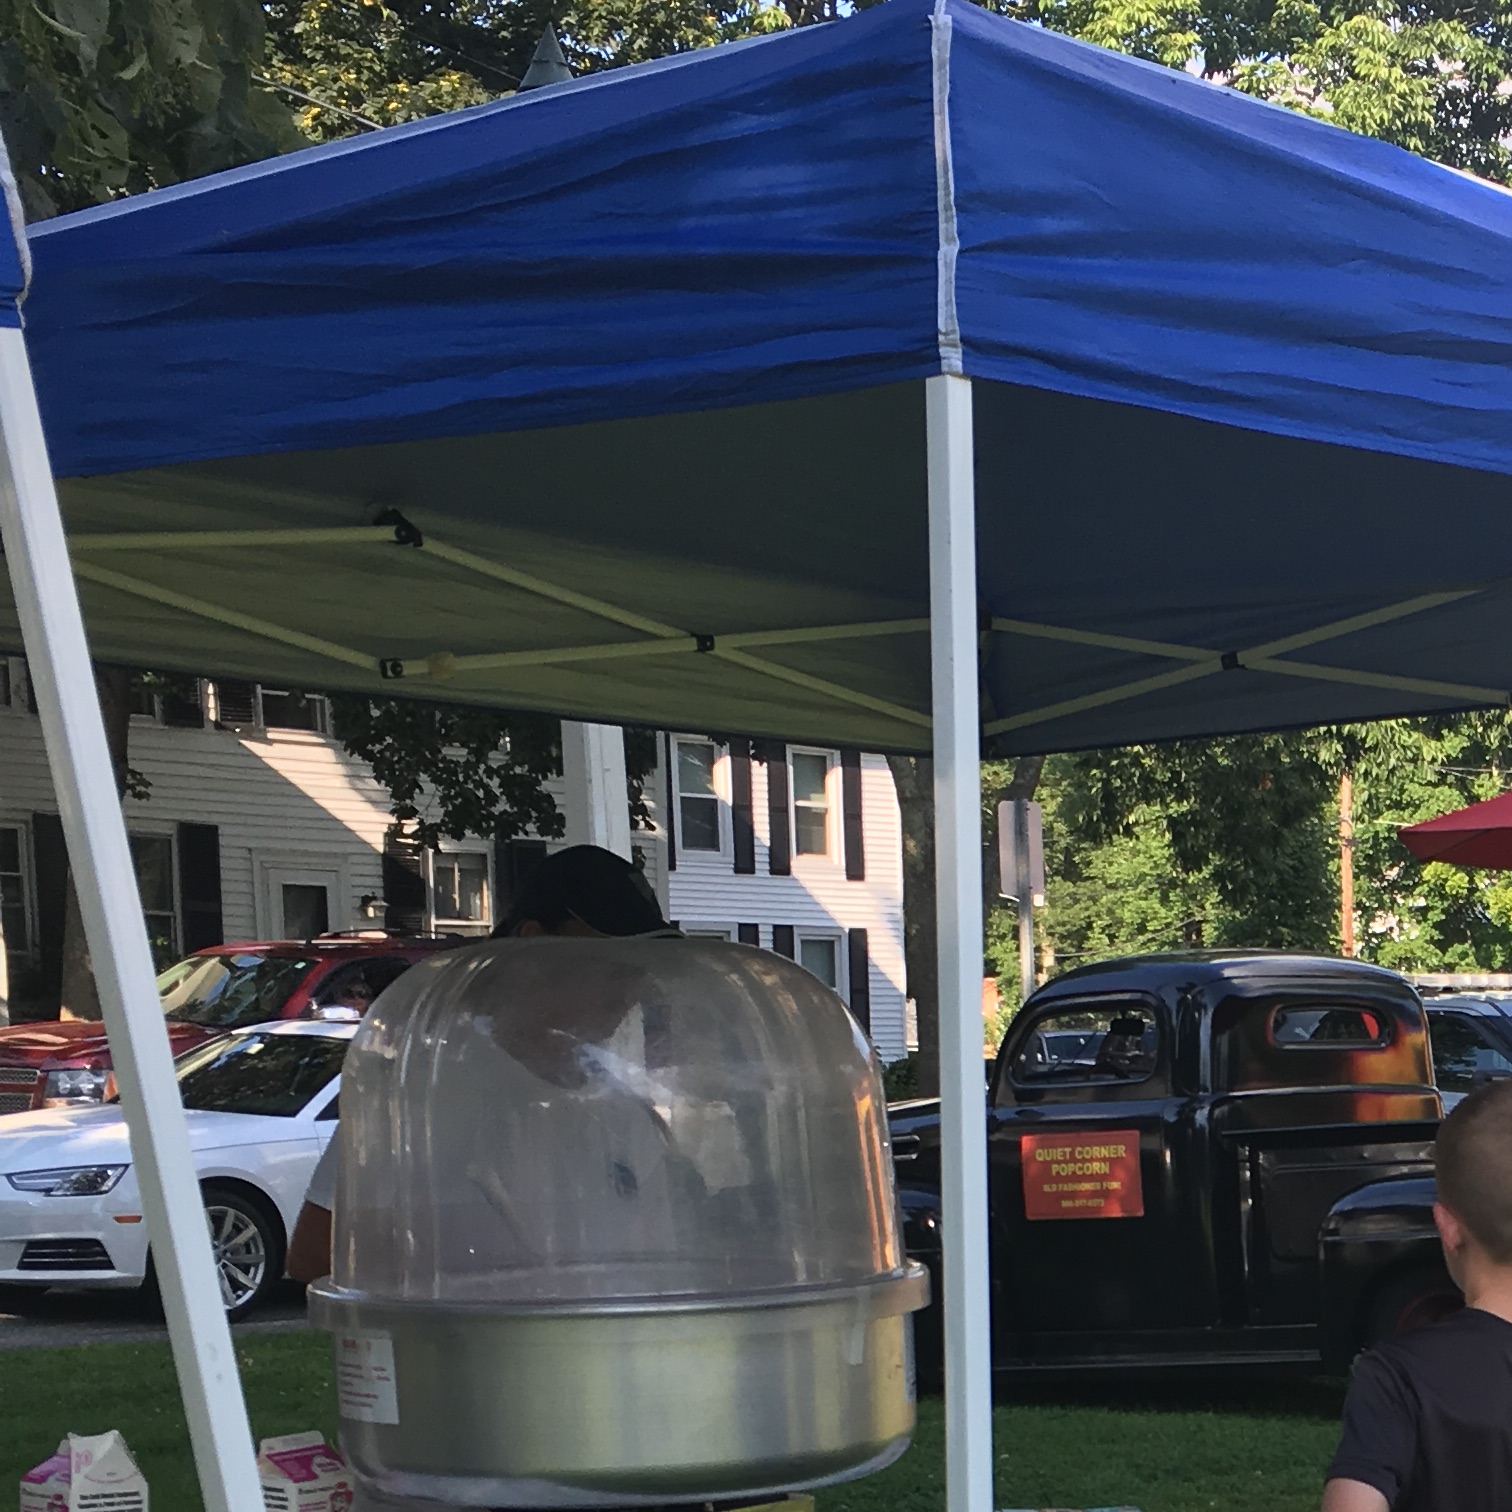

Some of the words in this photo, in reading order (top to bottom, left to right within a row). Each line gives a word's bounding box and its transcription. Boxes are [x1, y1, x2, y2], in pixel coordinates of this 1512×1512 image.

[1035, 1147, 1072, 1161] QUIET
[1075, 1145, 1126, 1159] CORNER
[1051, 1161, 1110, 1176] POPCORN
